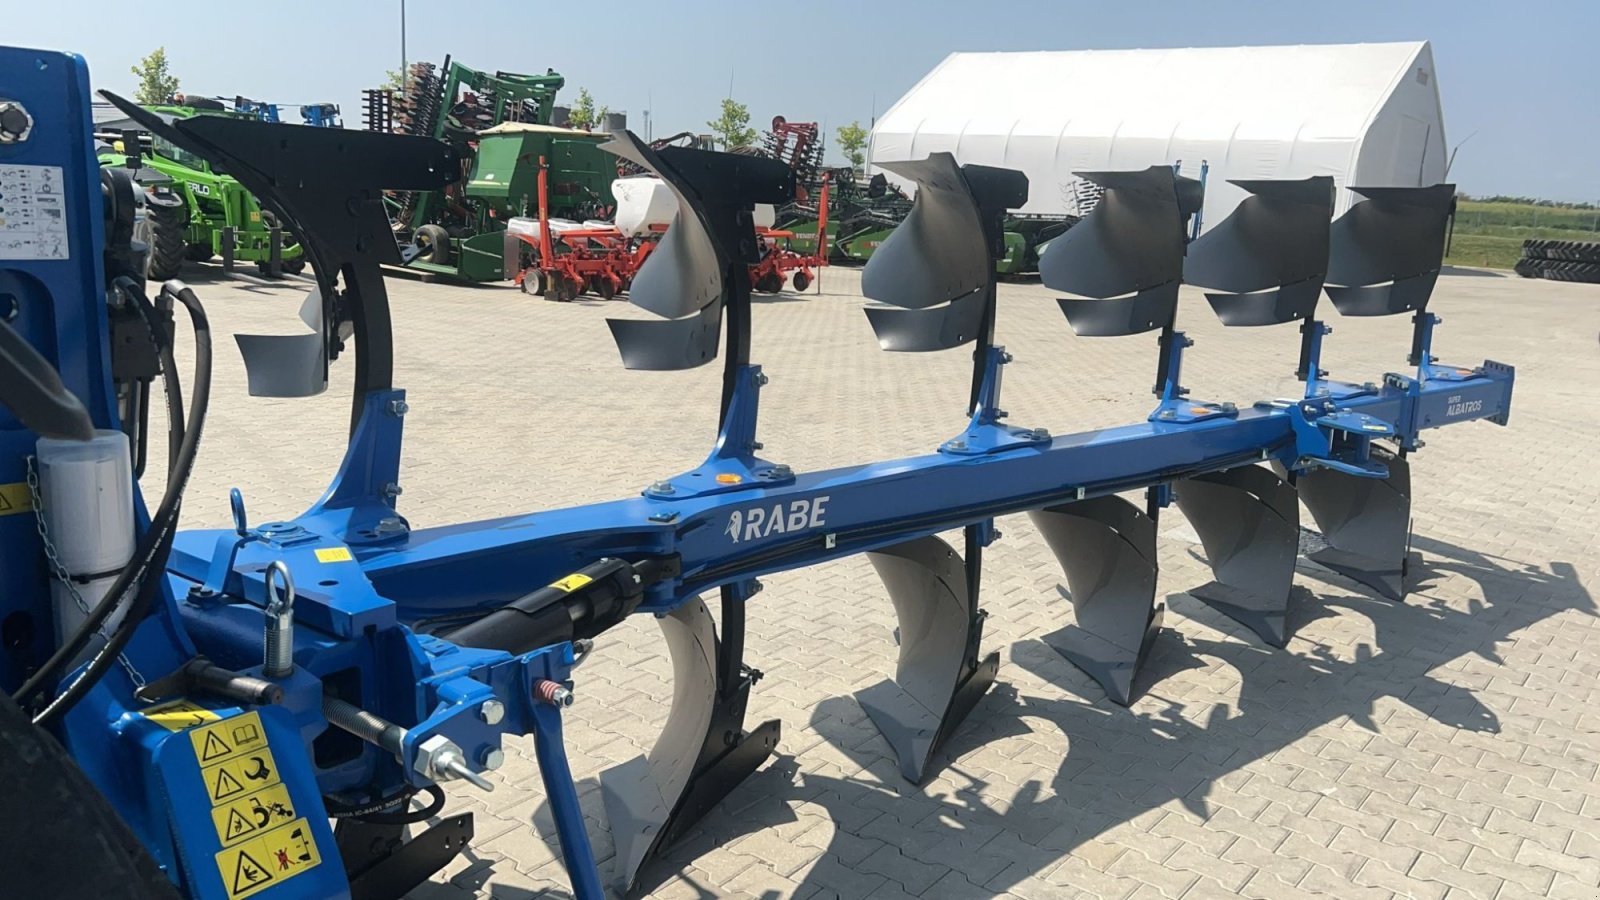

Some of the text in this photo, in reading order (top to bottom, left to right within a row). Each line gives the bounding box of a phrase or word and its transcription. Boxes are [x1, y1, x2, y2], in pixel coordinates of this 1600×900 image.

[187, 182, 210, 195] ERLO
[1447, 395, 1462, 404] SUPER
[1446, 400, 1483, 417] ALBATROS
[744, 496, 830, 541] RABE
